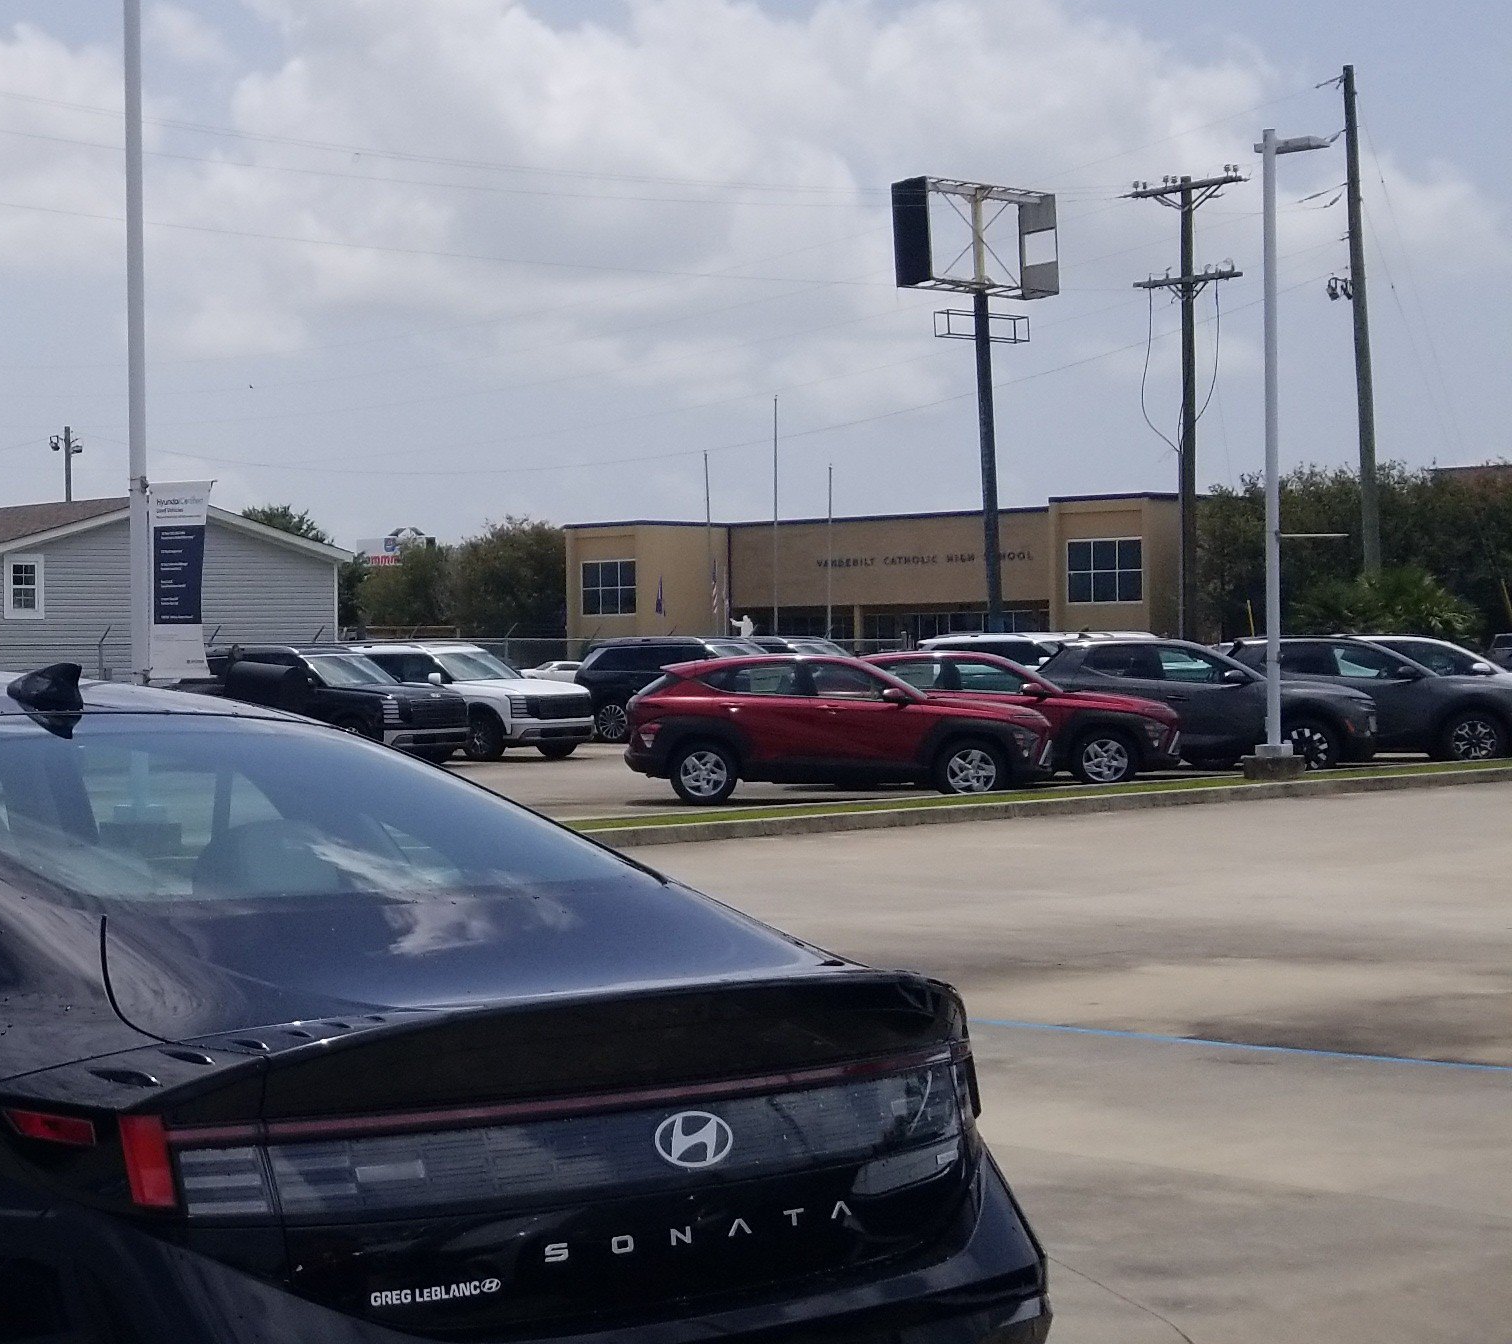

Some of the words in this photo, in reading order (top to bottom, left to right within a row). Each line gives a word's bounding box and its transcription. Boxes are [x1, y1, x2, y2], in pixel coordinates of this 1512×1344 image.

[544, 1200, 852, 1263] SONATA
[370, 1289, 412, 1307] GREG
[415, 1280, 481, 1302] LEBLANC
